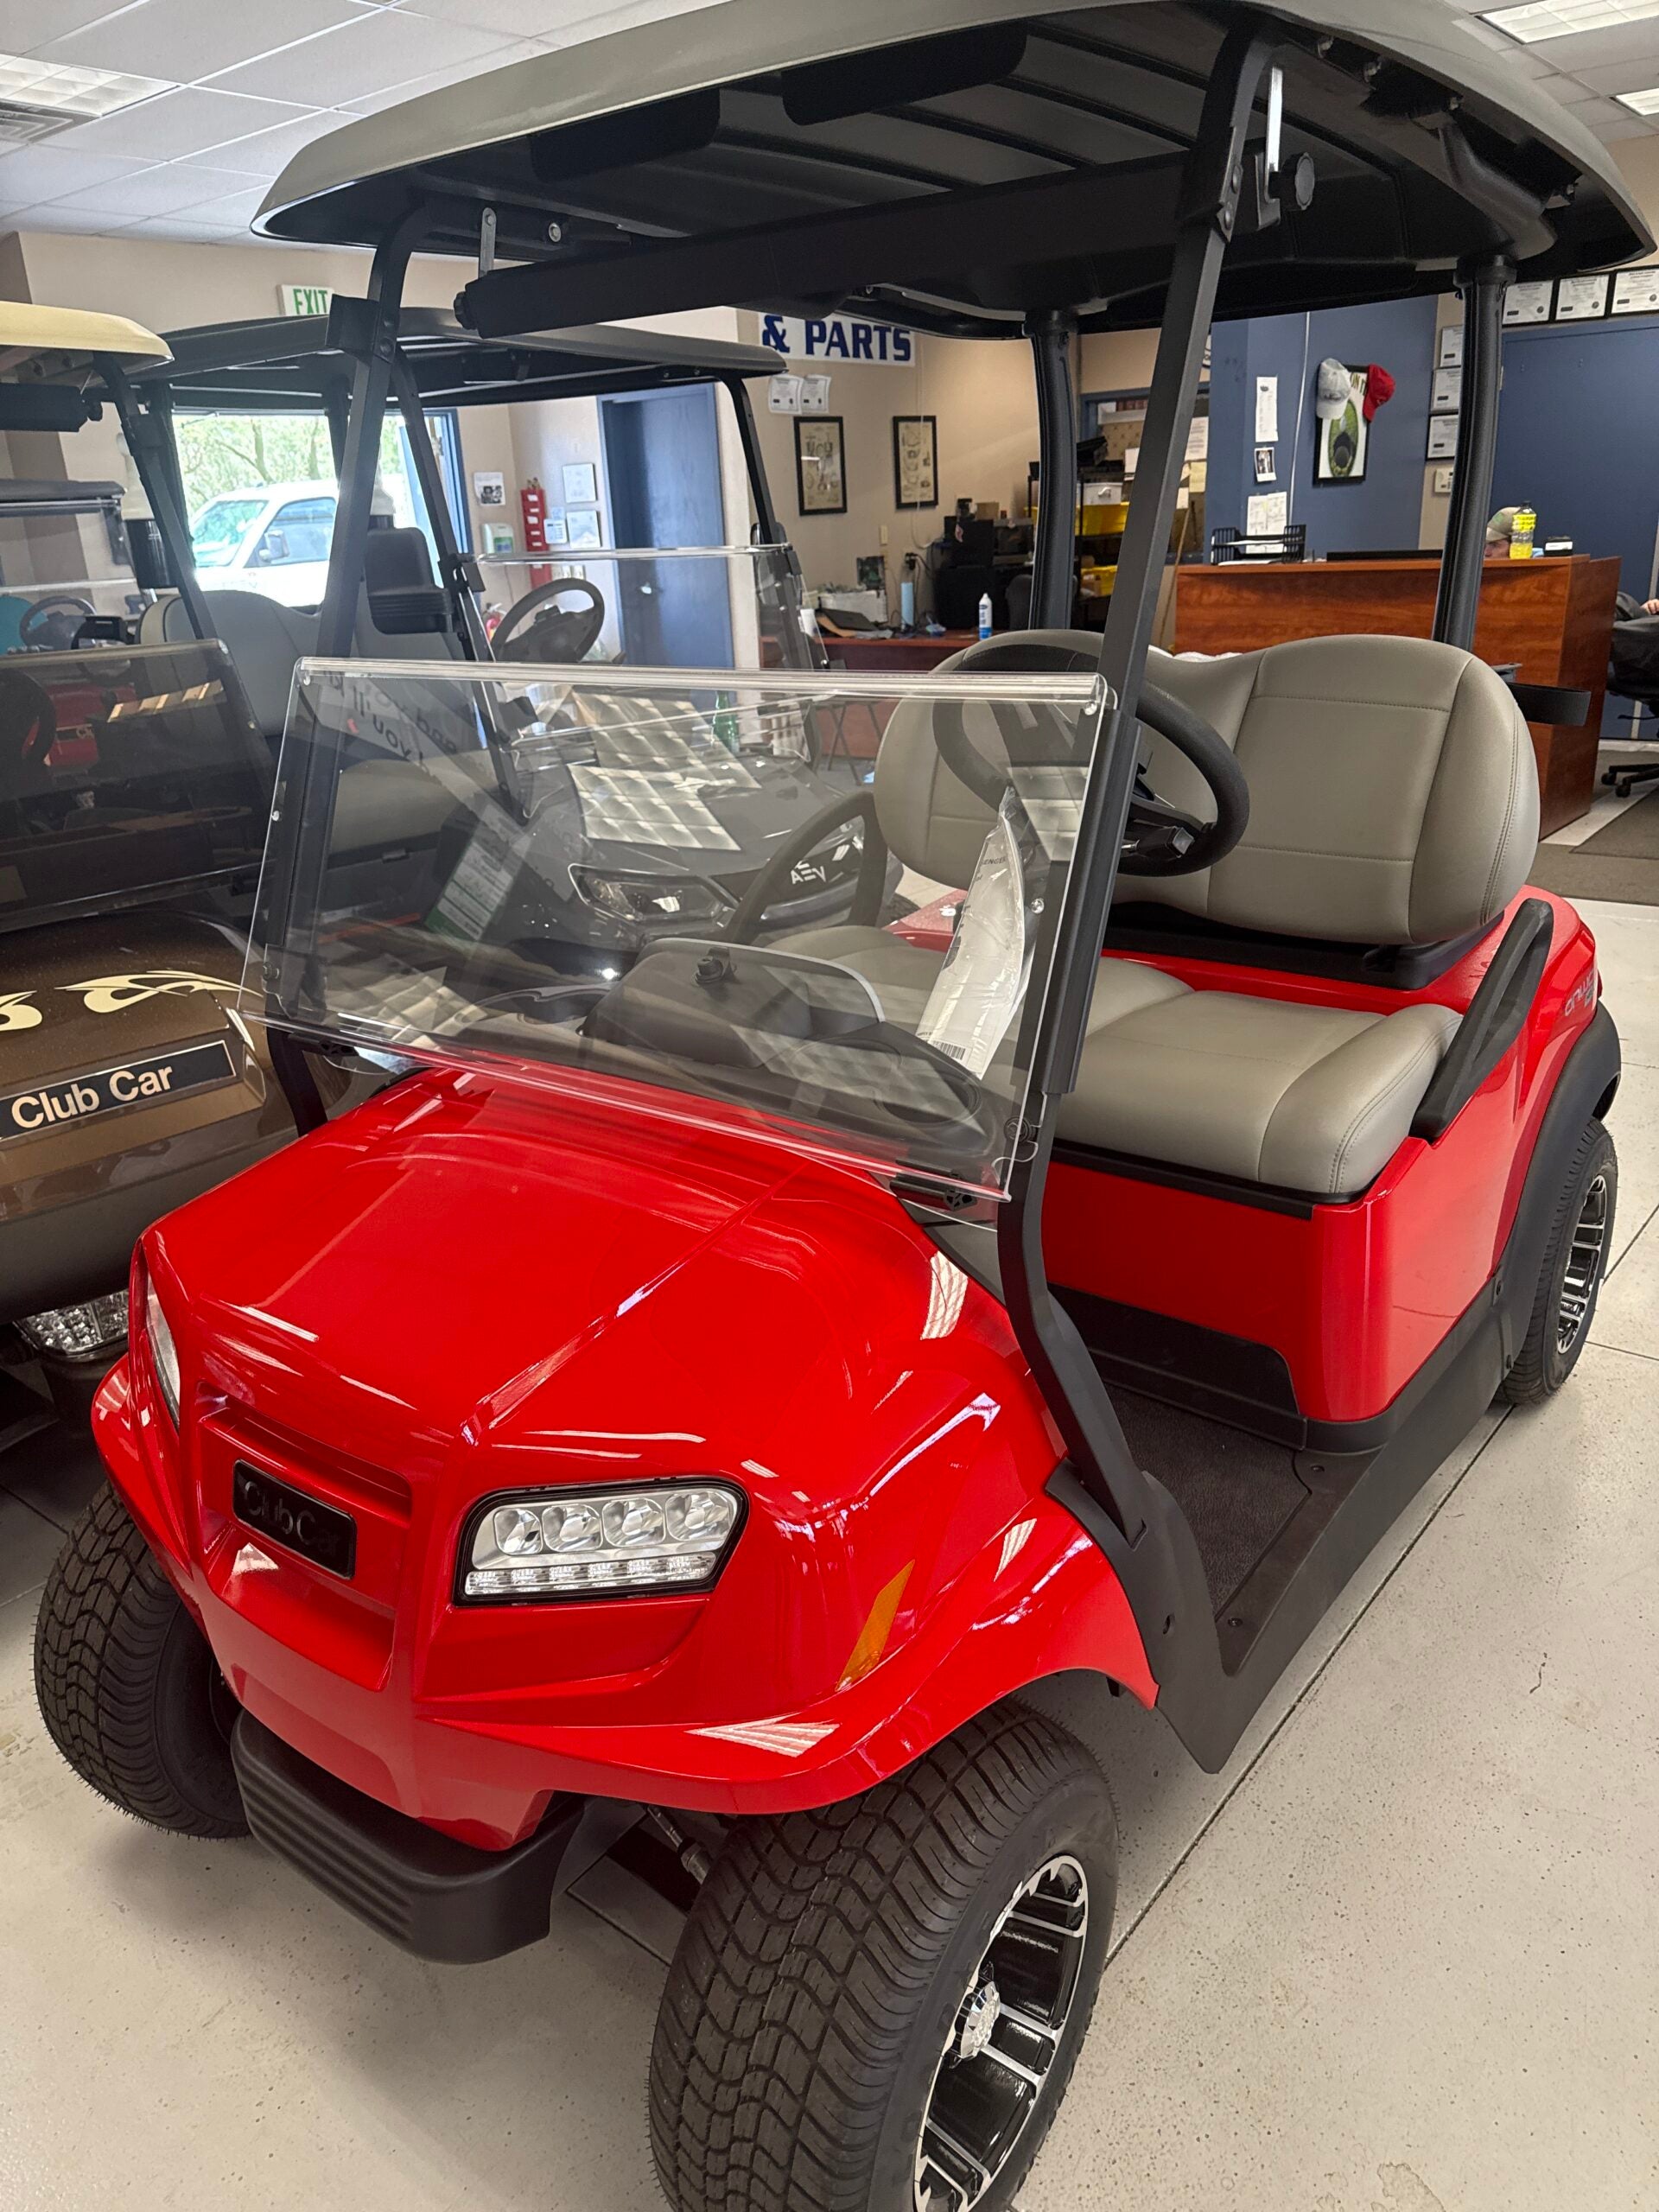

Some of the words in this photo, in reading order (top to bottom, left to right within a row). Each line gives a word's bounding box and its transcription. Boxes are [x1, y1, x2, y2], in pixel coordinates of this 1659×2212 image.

[293, 289, 327, 315] EXIT
[762, 315, 790, 353] &
[805, 320, 911, 361] PARTS
[11, 1084, 100, 1128] Club
[109, 1065, 173, 1102] Car
